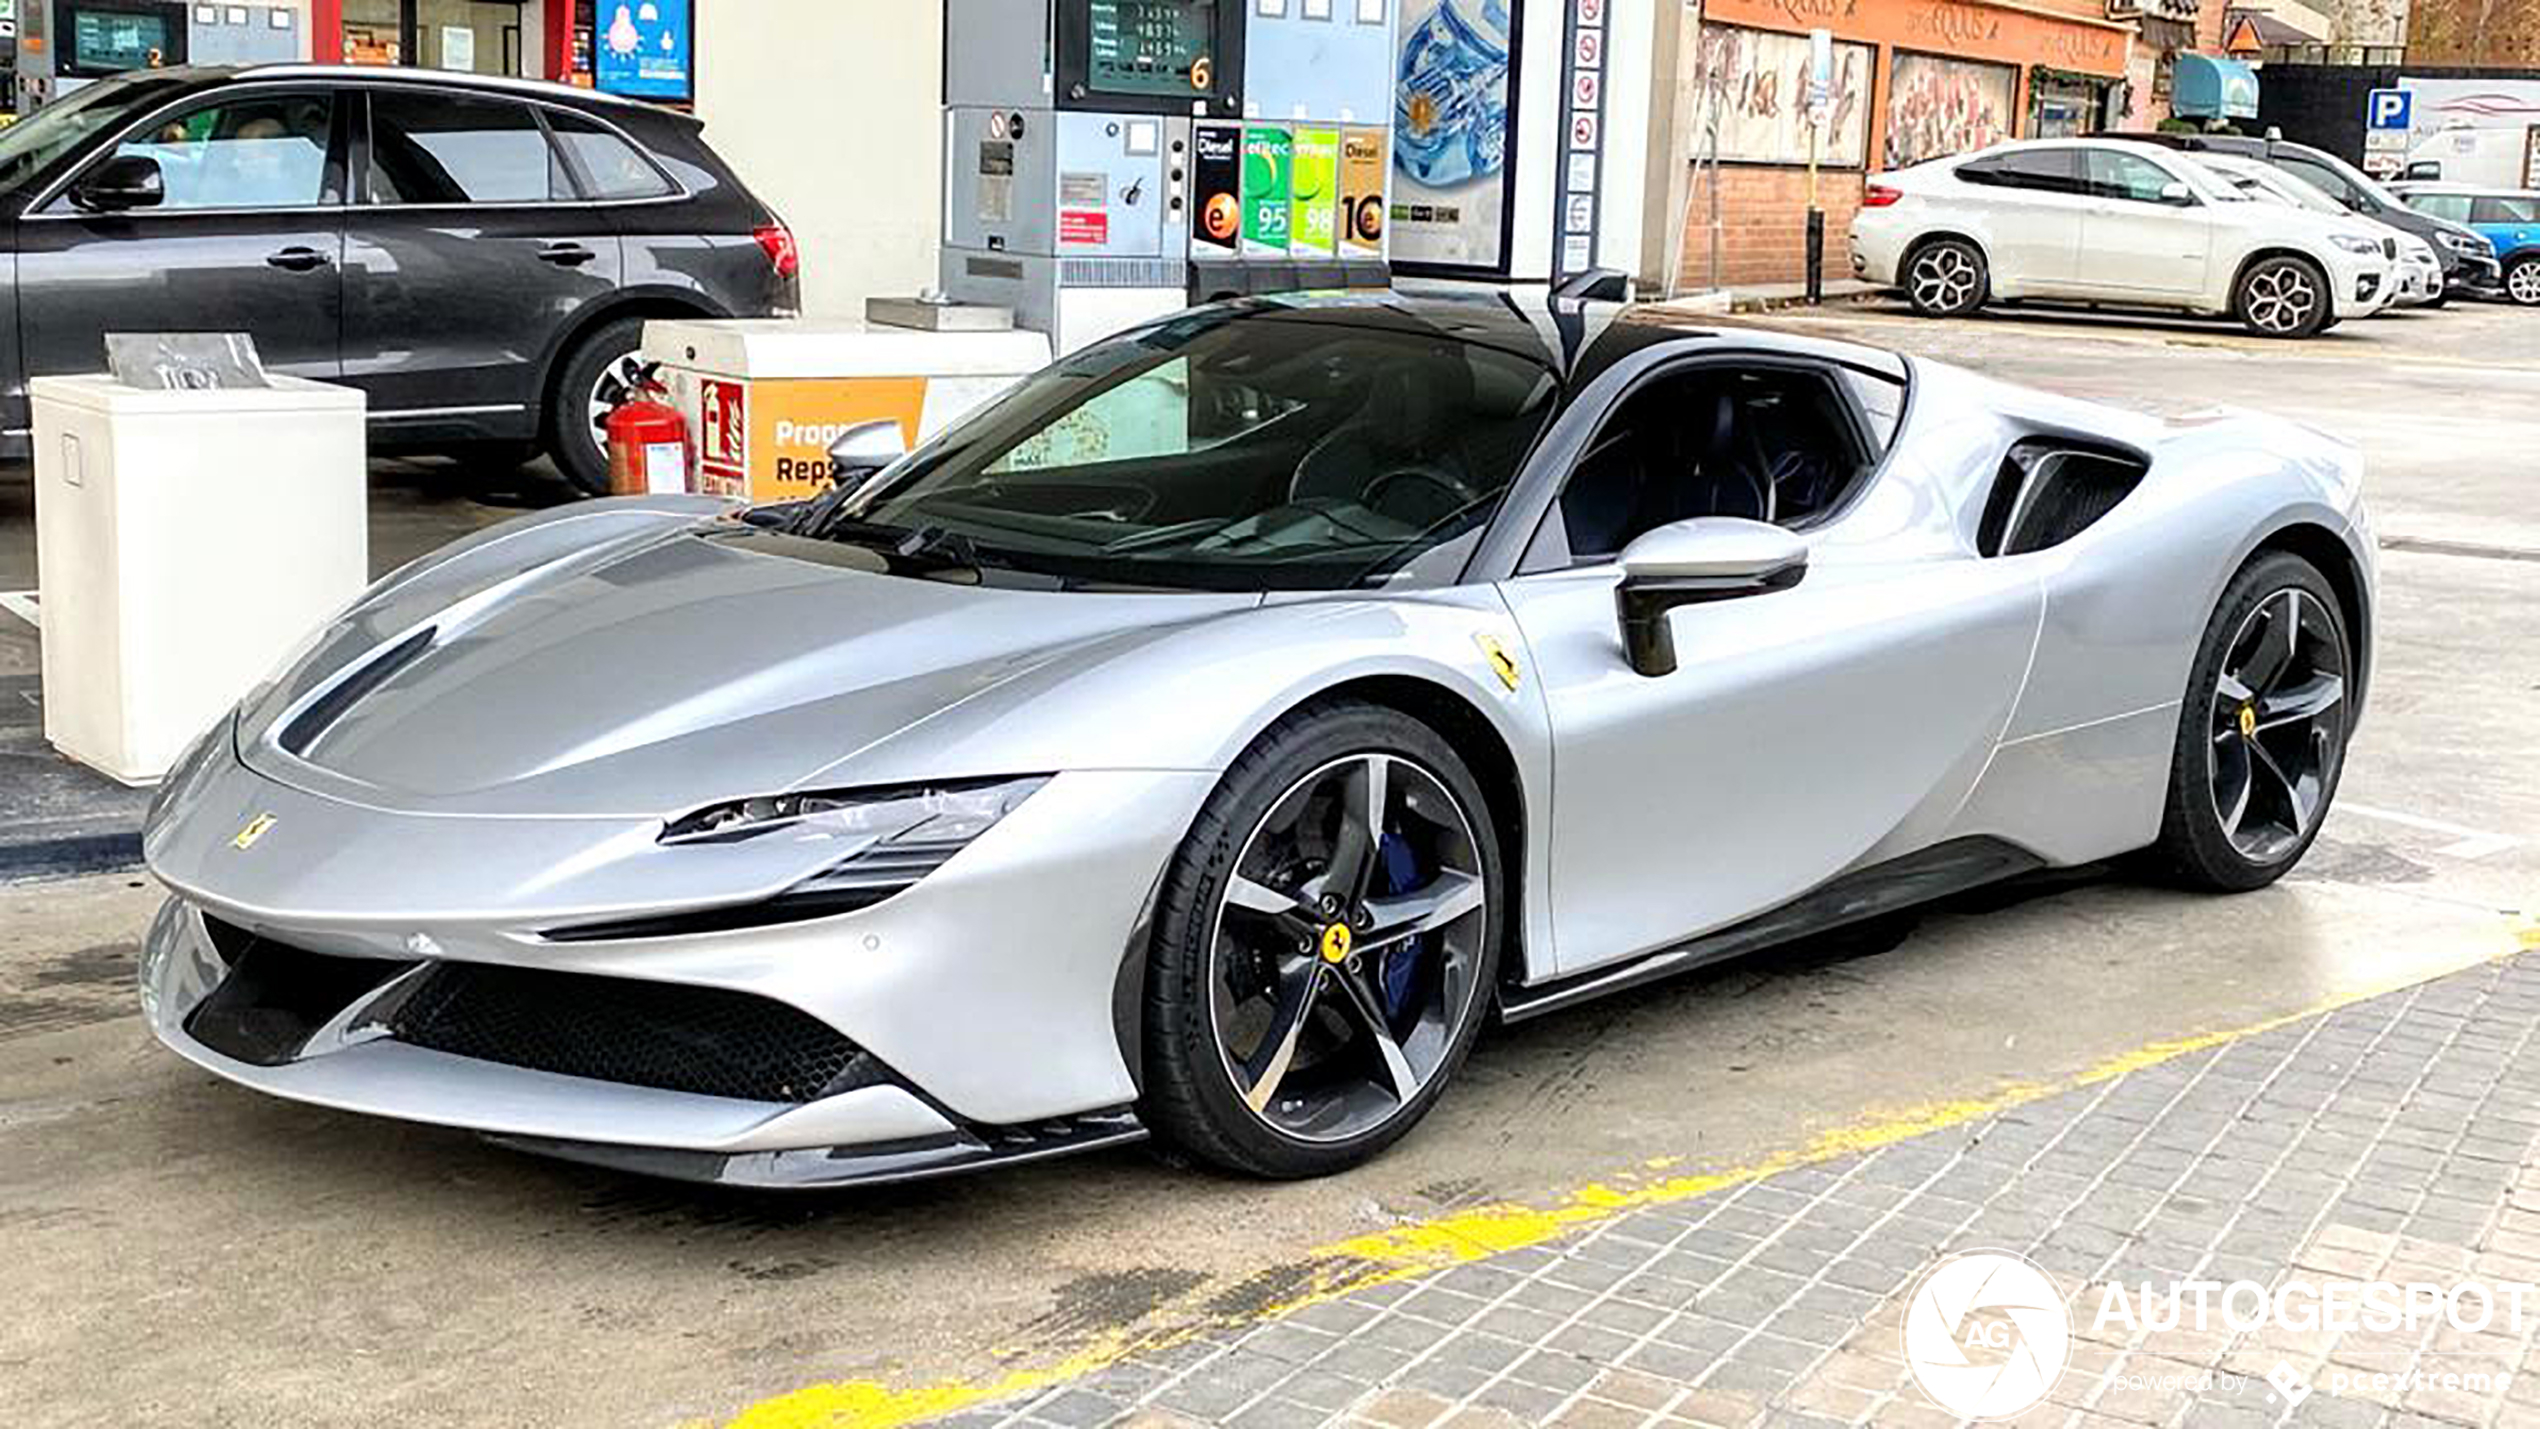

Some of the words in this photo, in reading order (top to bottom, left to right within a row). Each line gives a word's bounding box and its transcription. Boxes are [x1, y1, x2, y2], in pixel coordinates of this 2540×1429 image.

[1190, 57, 1210, 90] 6
[2376, 95, 2404, 126] P
[1198, 139, 1233, 154] Diesel
[1209, 208, 1224, 231] e
[1258, 207, 1287, 233] 95
[1305, 209, 1333, 235] 98
